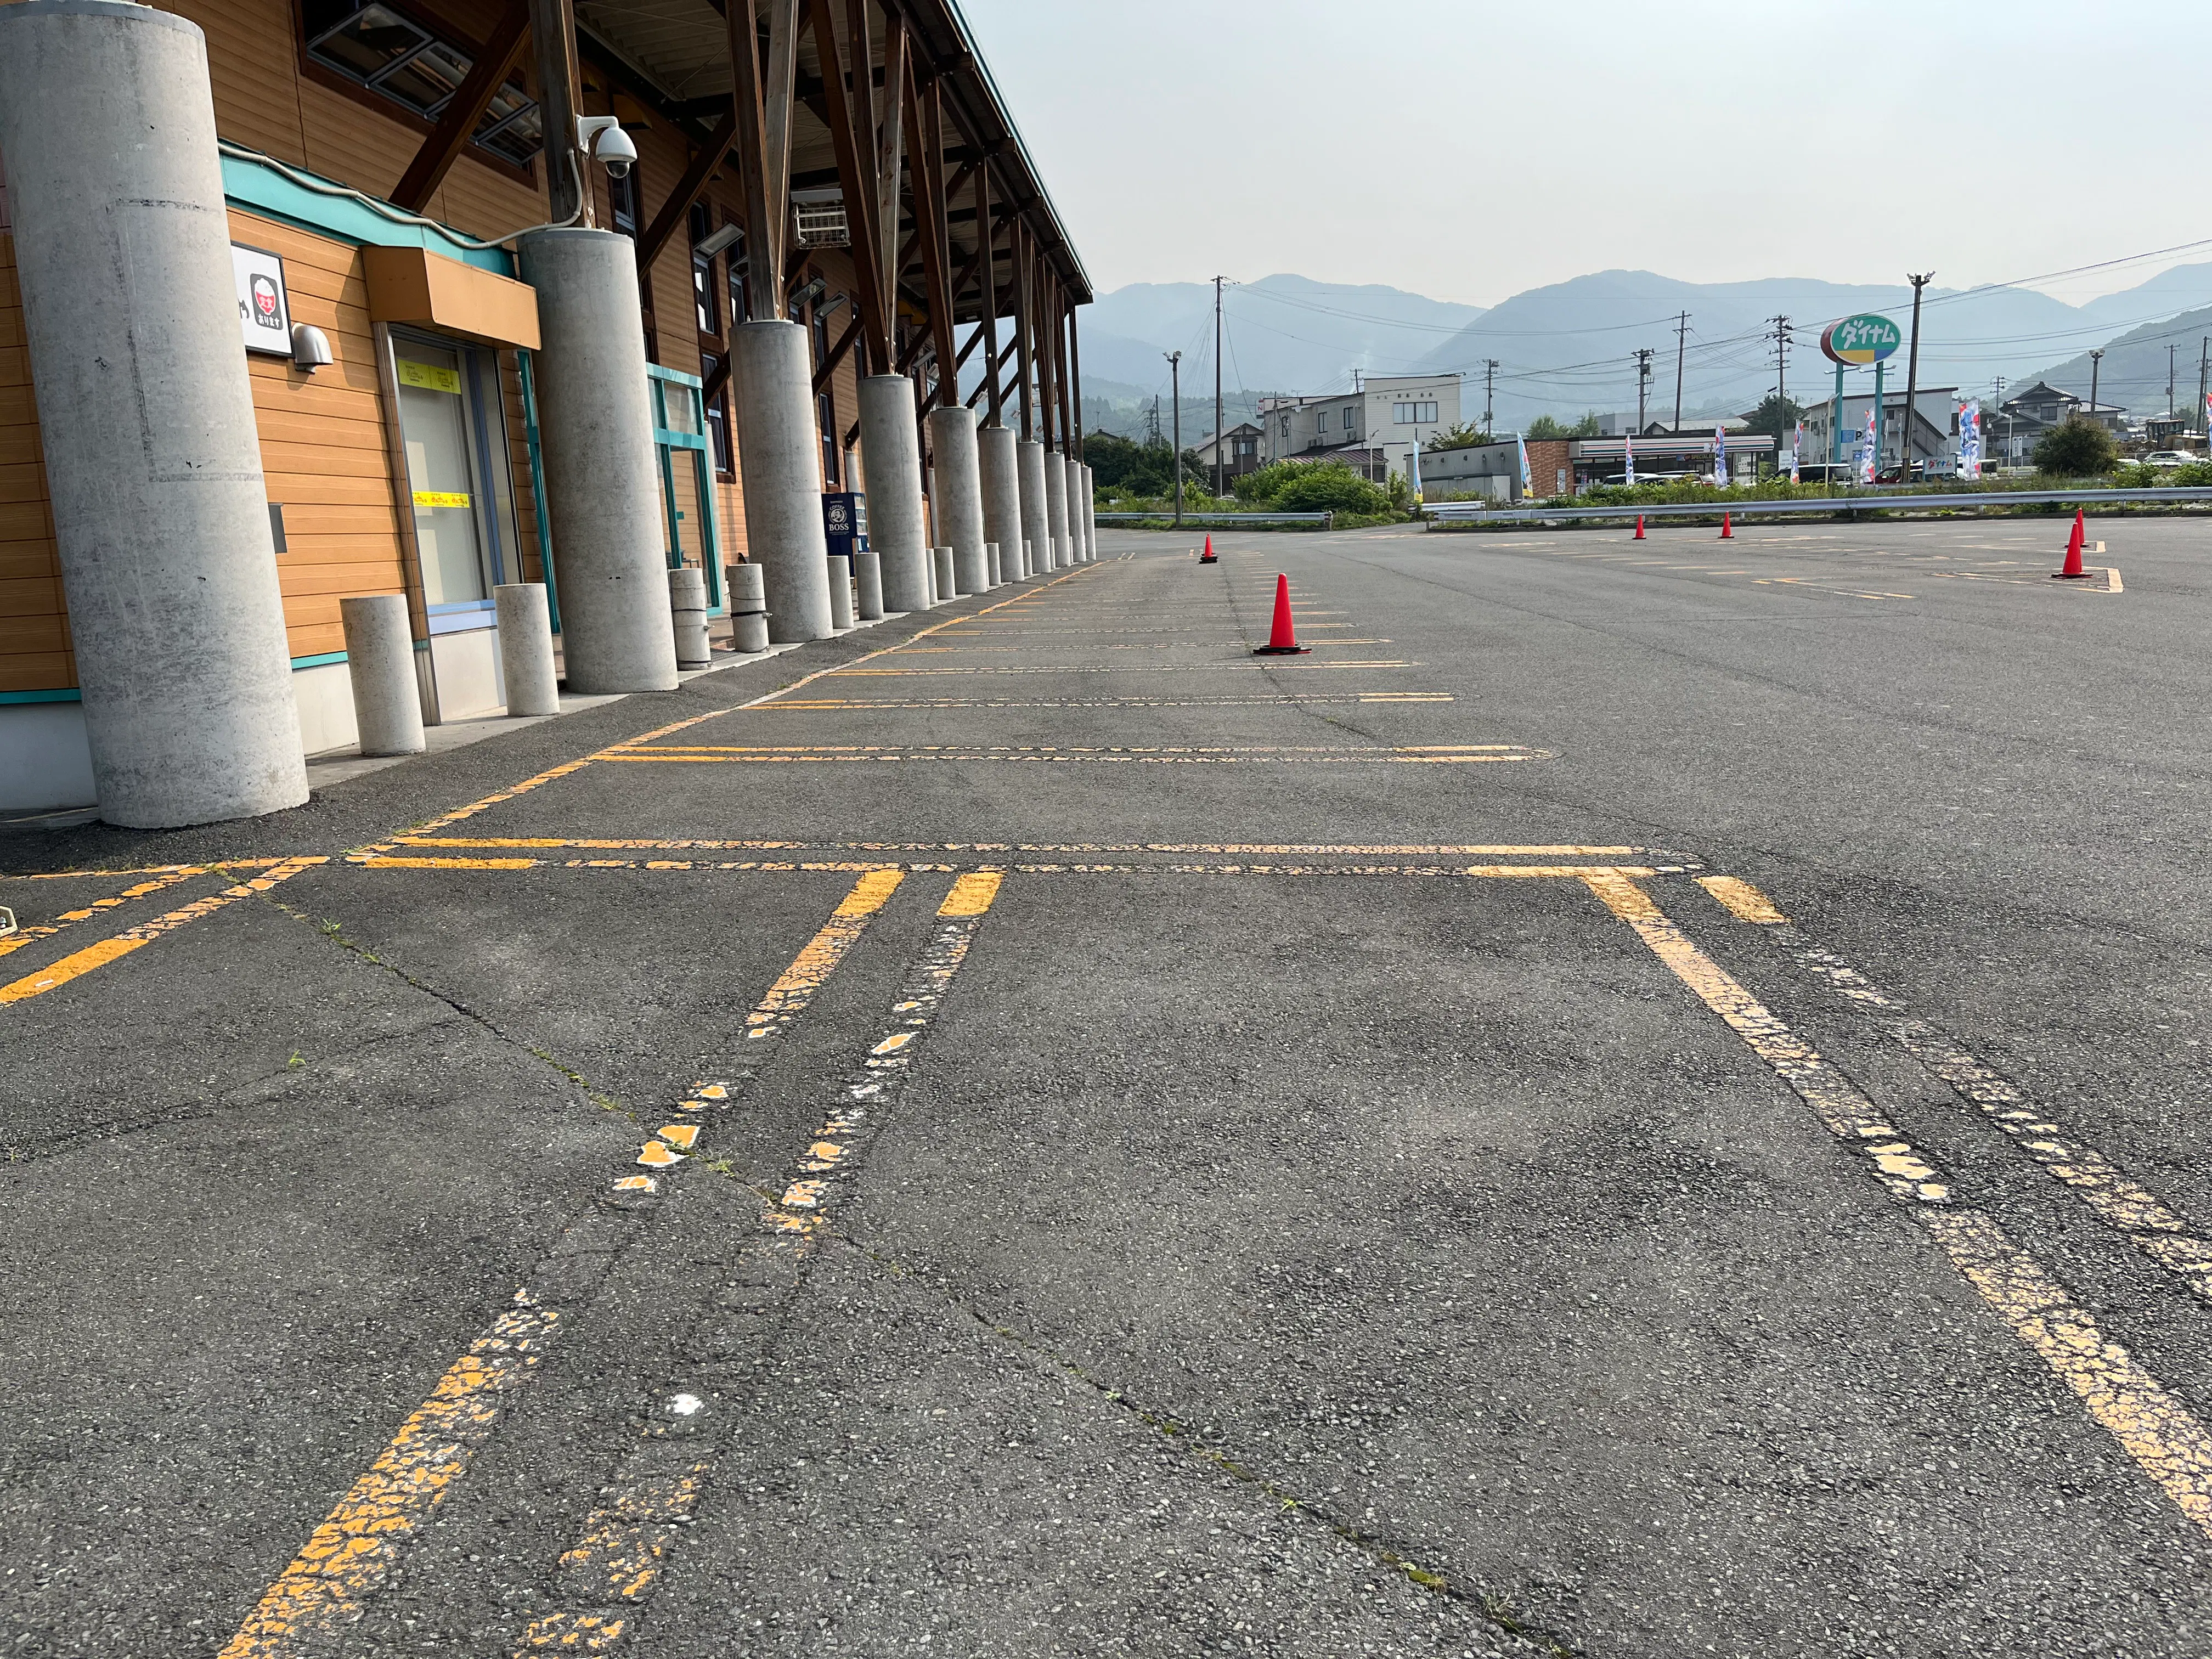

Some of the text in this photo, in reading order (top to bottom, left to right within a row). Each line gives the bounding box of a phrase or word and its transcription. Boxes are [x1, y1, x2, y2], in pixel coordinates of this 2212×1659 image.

[259, 296, 274, 310] 定食
[258, 313, 280, 328] あります
[1841, 320, 1895, 349] ダイナム
[1928, 459, 1952, 470] ダイナム
[829, 523, 849, 531] BOSS
